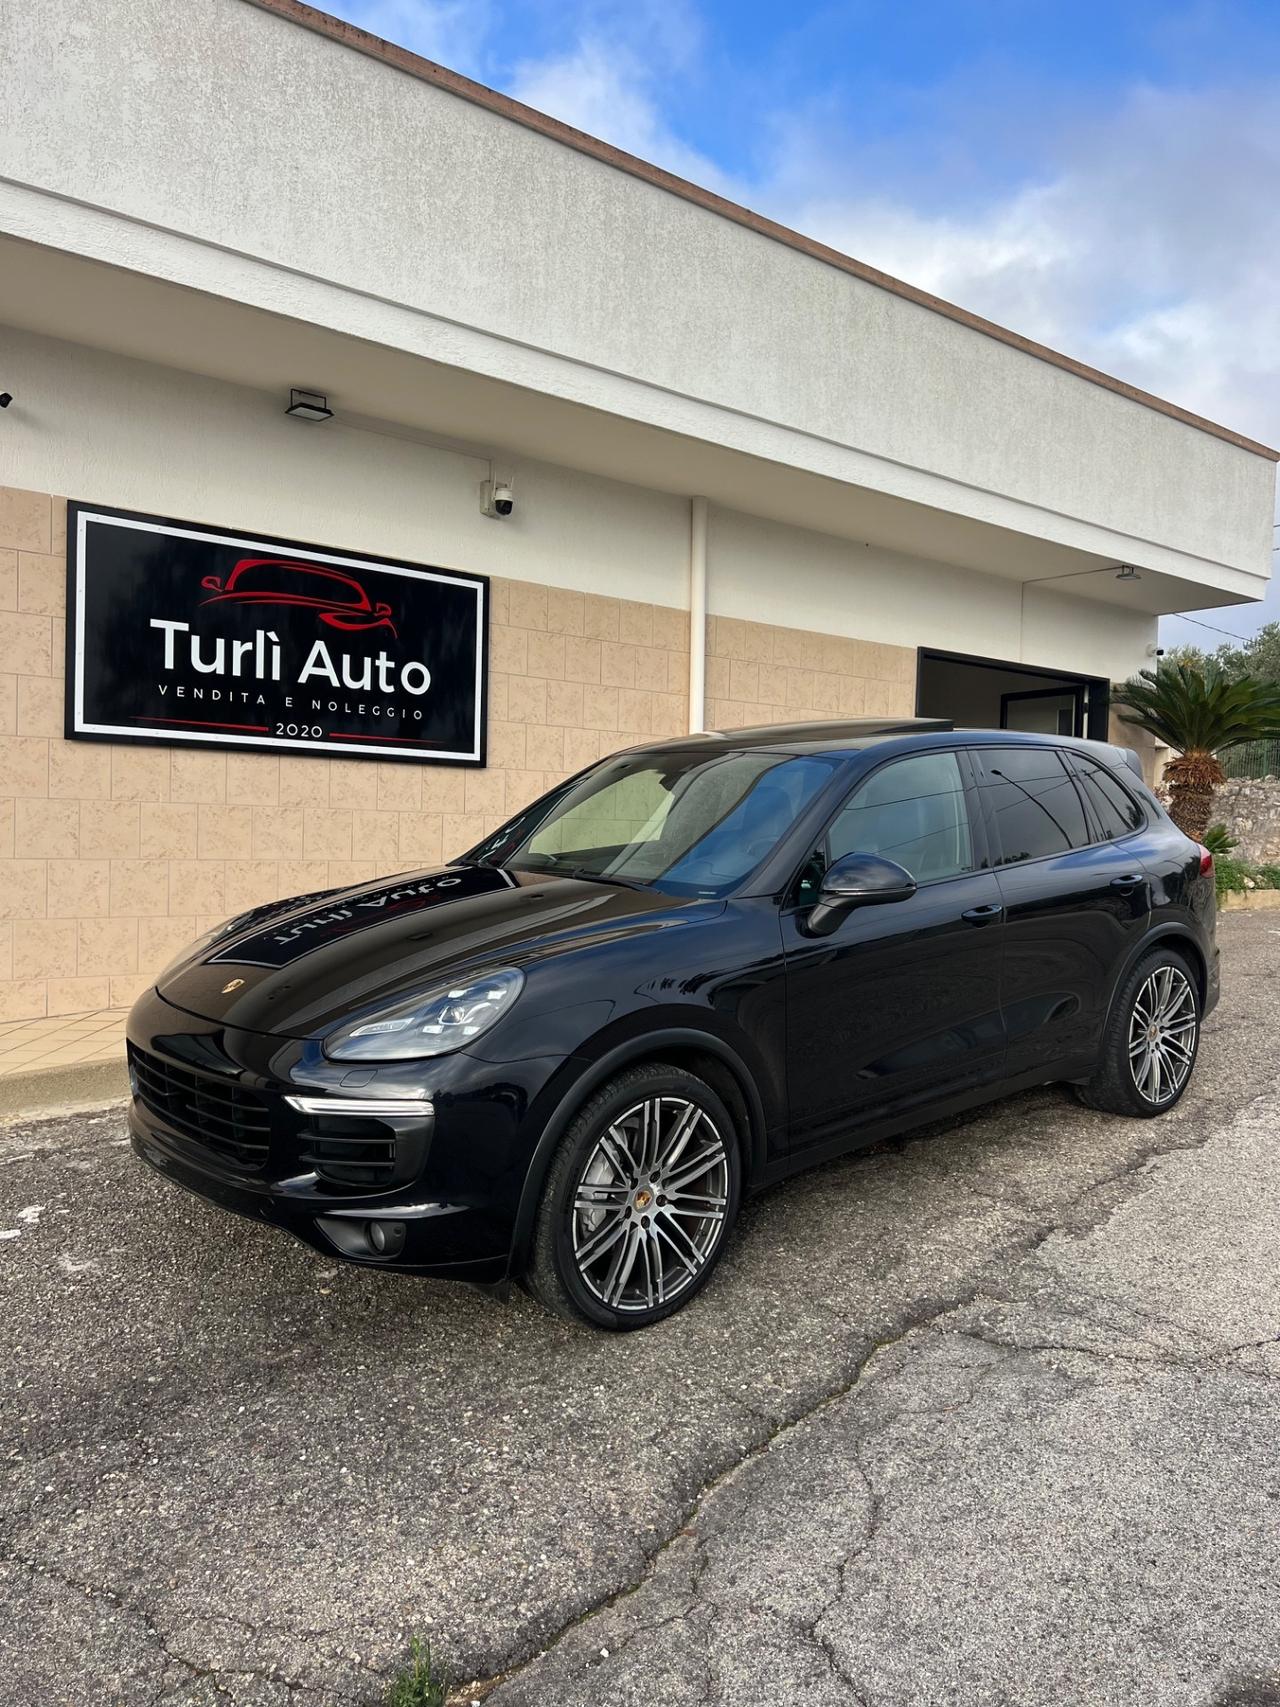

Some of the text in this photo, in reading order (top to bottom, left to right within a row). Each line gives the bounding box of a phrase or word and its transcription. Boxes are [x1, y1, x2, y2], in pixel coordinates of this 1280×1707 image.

[149, 618, 432, 696] Turlì Auto
[158, 684, 423, 720] VENDITA E NOLEGGIO
[275, 722, 323, 738] 2020
